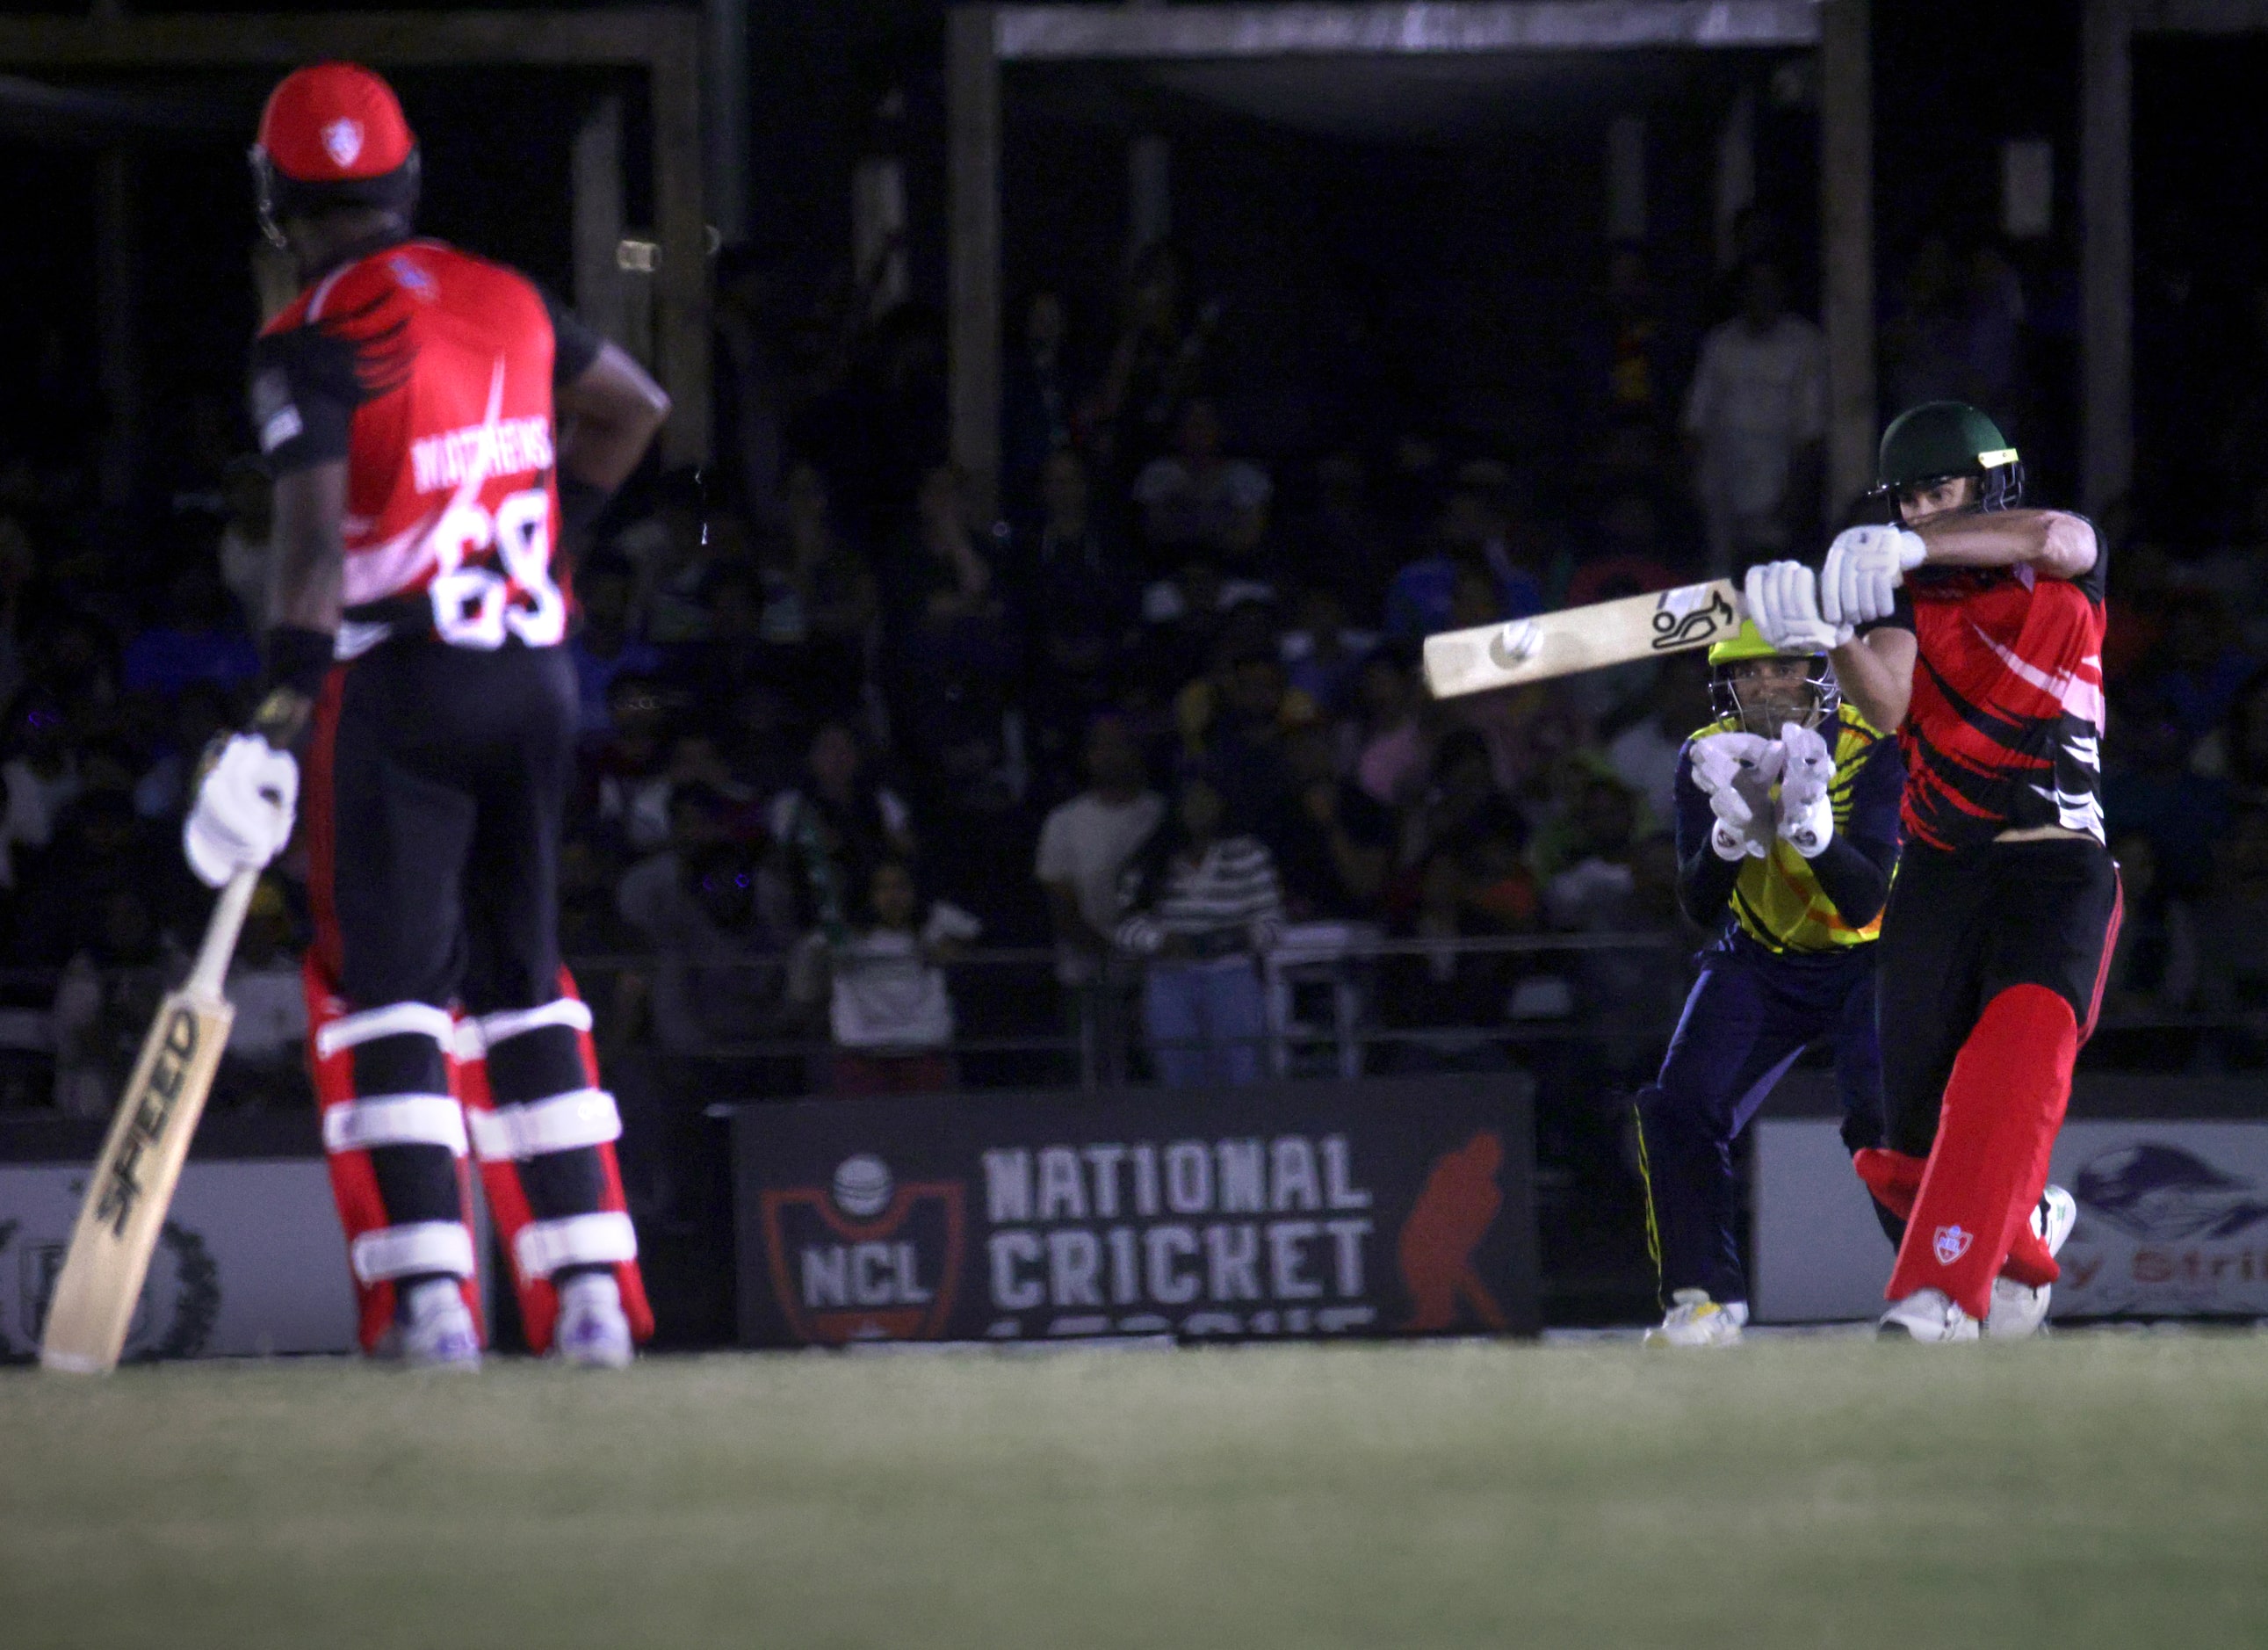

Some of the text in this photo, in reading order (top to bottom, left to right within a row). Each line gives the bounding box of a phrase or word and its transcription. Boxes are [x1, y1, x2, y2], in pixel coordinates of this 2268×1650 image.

[429, 488, 566, 651] 69
[97, 1007, 200, 1241] SPEED
[982, 1133, 1373, 1222] NATIONAL
[800, 1240, 934, 1308] NCL
[988, 1218, 1374, 1310] CRICKET
